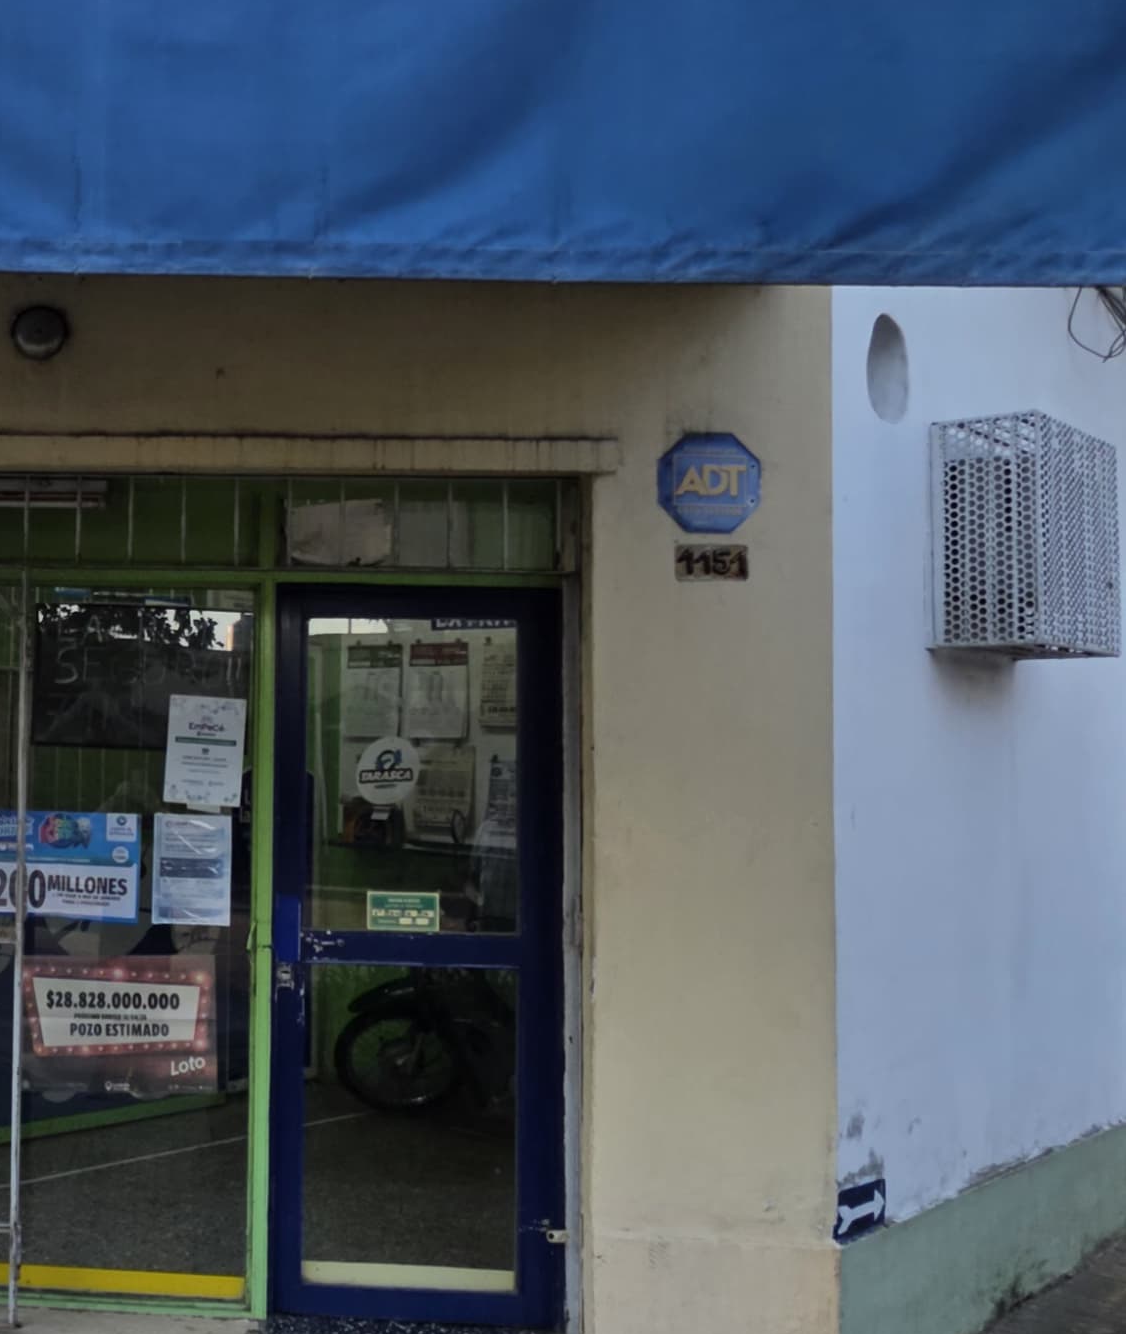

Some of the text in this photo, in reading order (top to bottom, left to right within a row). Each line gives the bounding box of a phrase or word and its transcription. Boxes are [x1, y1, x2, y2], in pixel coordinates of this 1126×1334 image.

[674, 464, 746, 496] ADT
[47, 875, 128, 896] MILLONES
[46, 989, 180, 1010] $28.828.000.000
[70, 1022, 169, 1037] POZO ESTIMADO
[170, 1055, 206, 1076] Loto
